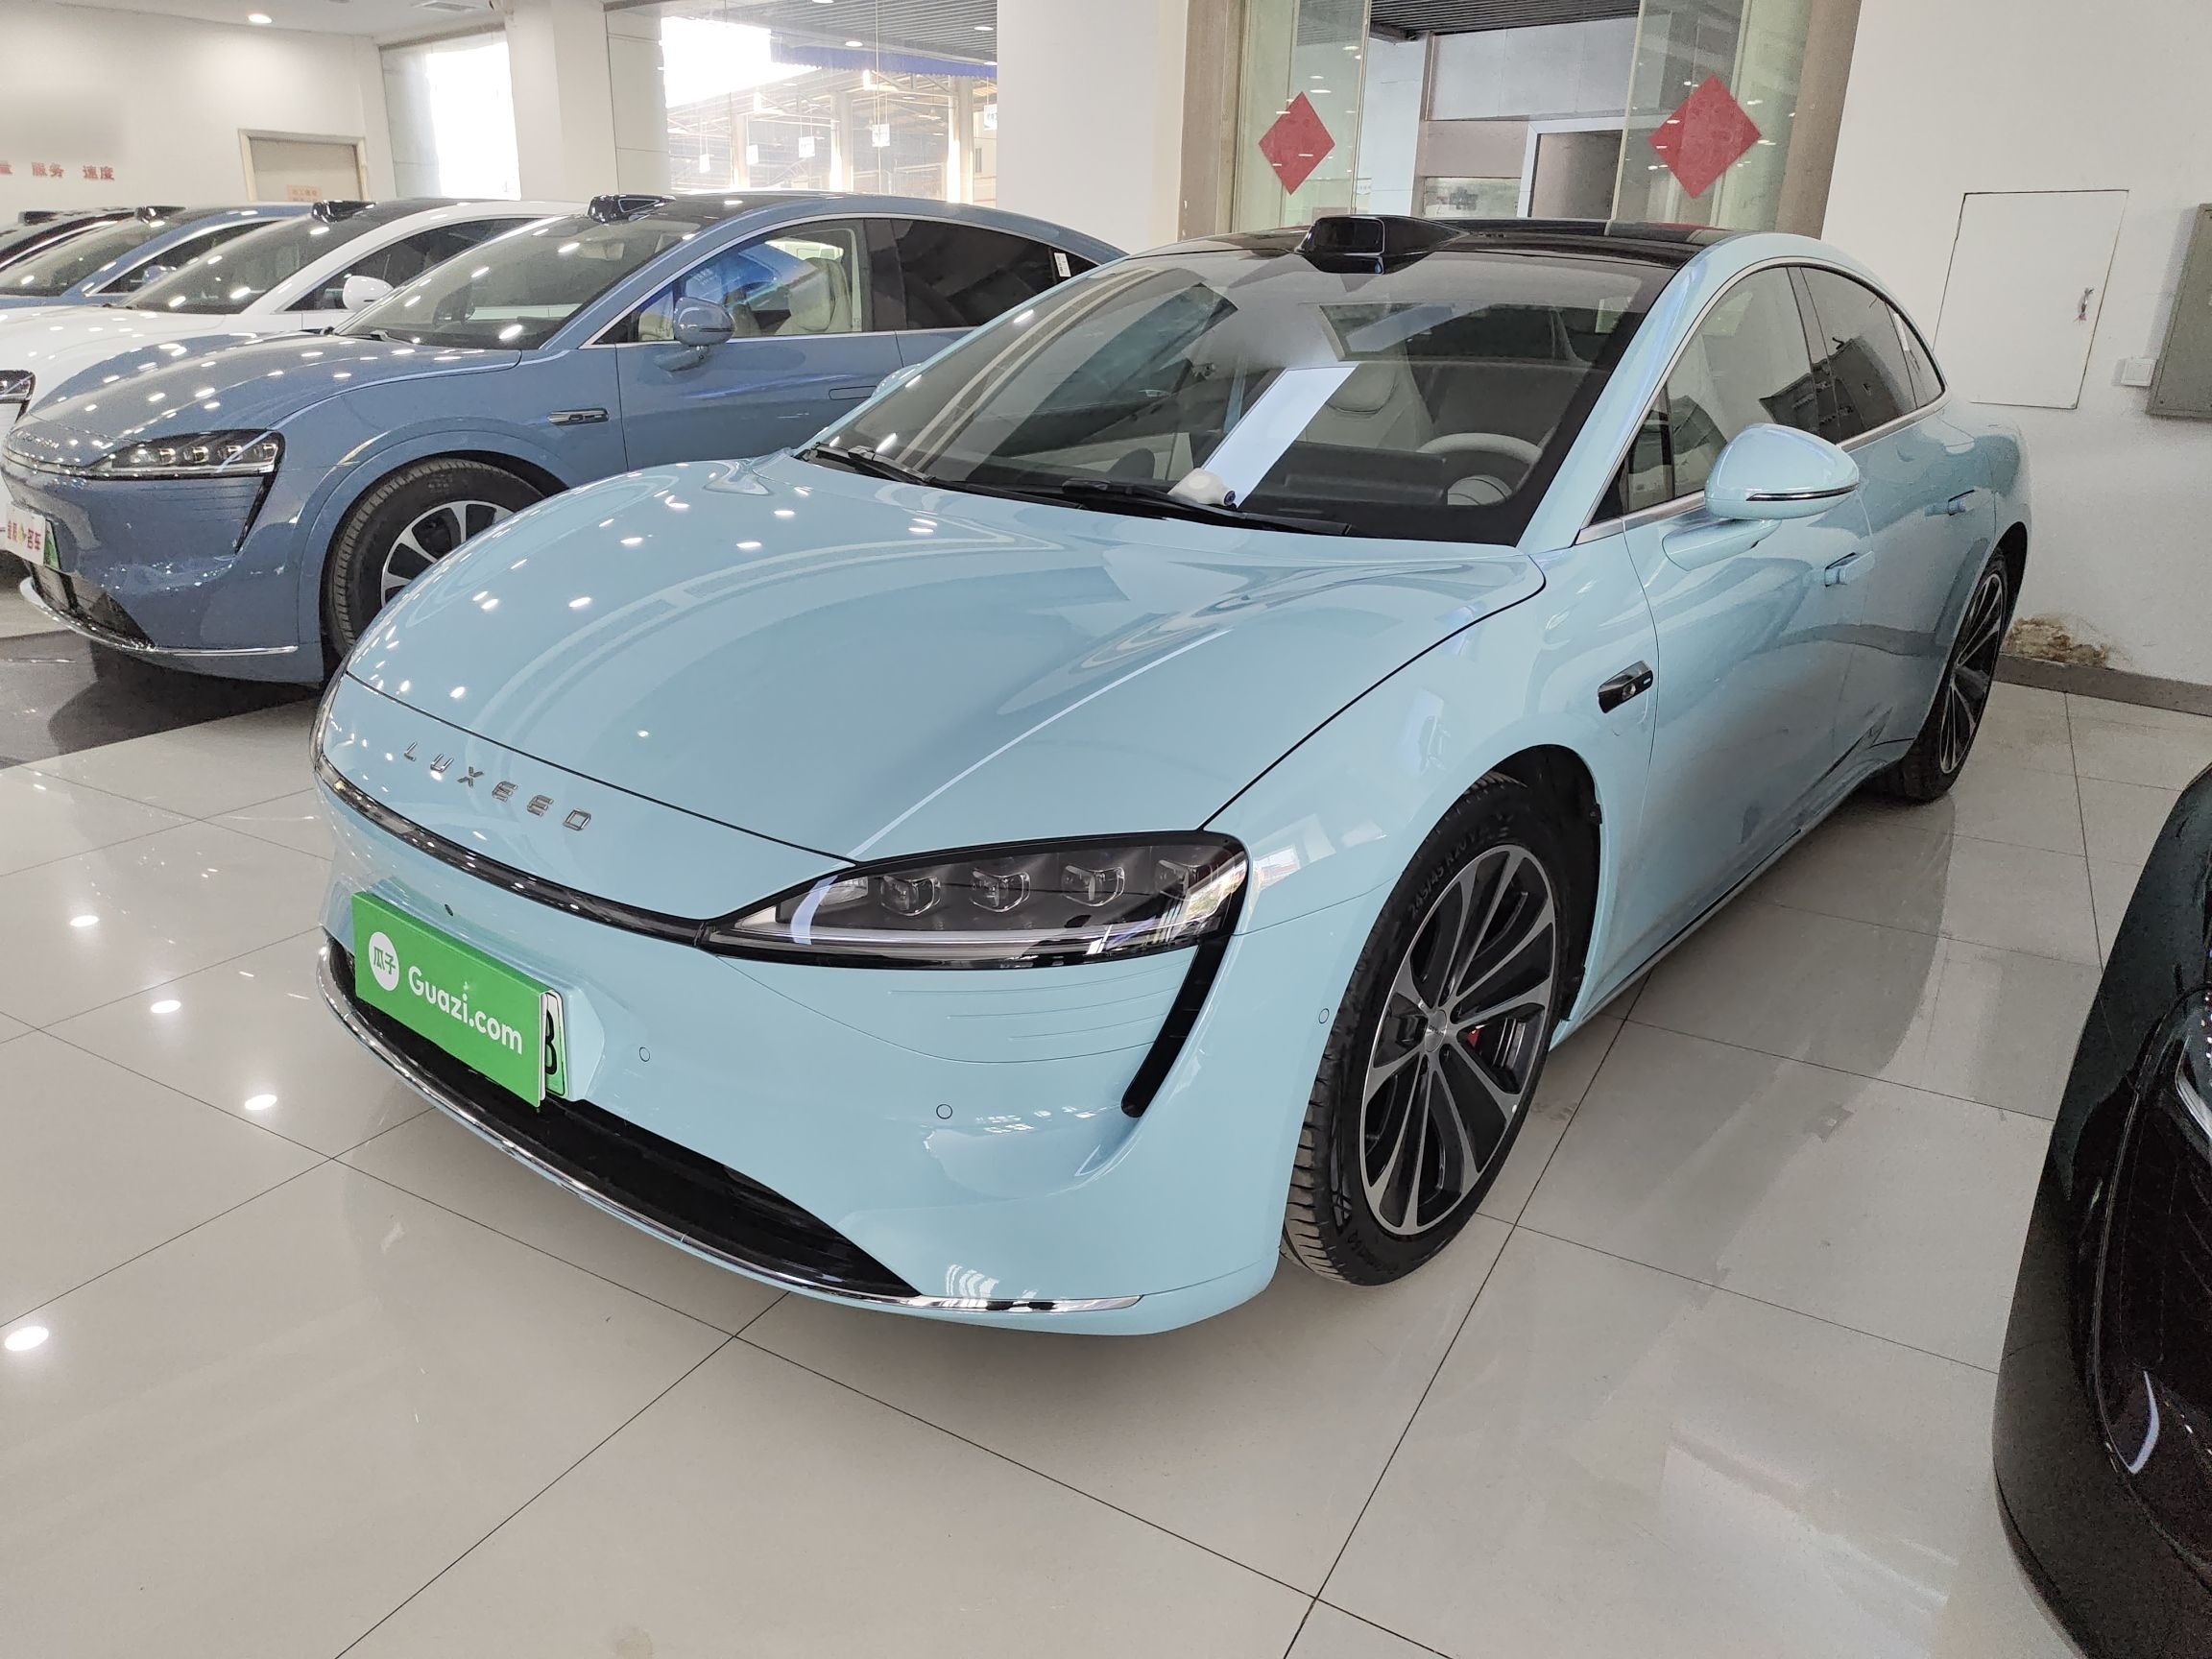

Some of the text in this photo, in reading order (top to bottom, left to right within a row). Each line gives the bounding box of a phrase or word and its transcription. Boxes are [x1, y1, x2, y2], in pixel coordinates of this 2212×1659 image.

[32, 161, 64, 178] 服务
[83, 165, 114, 180] 速度
[404, 742, 591, 831] LUXEED
[373, 946, 397, 975] 瓜子
[409, 966, 522, 1054] Guazi.com
